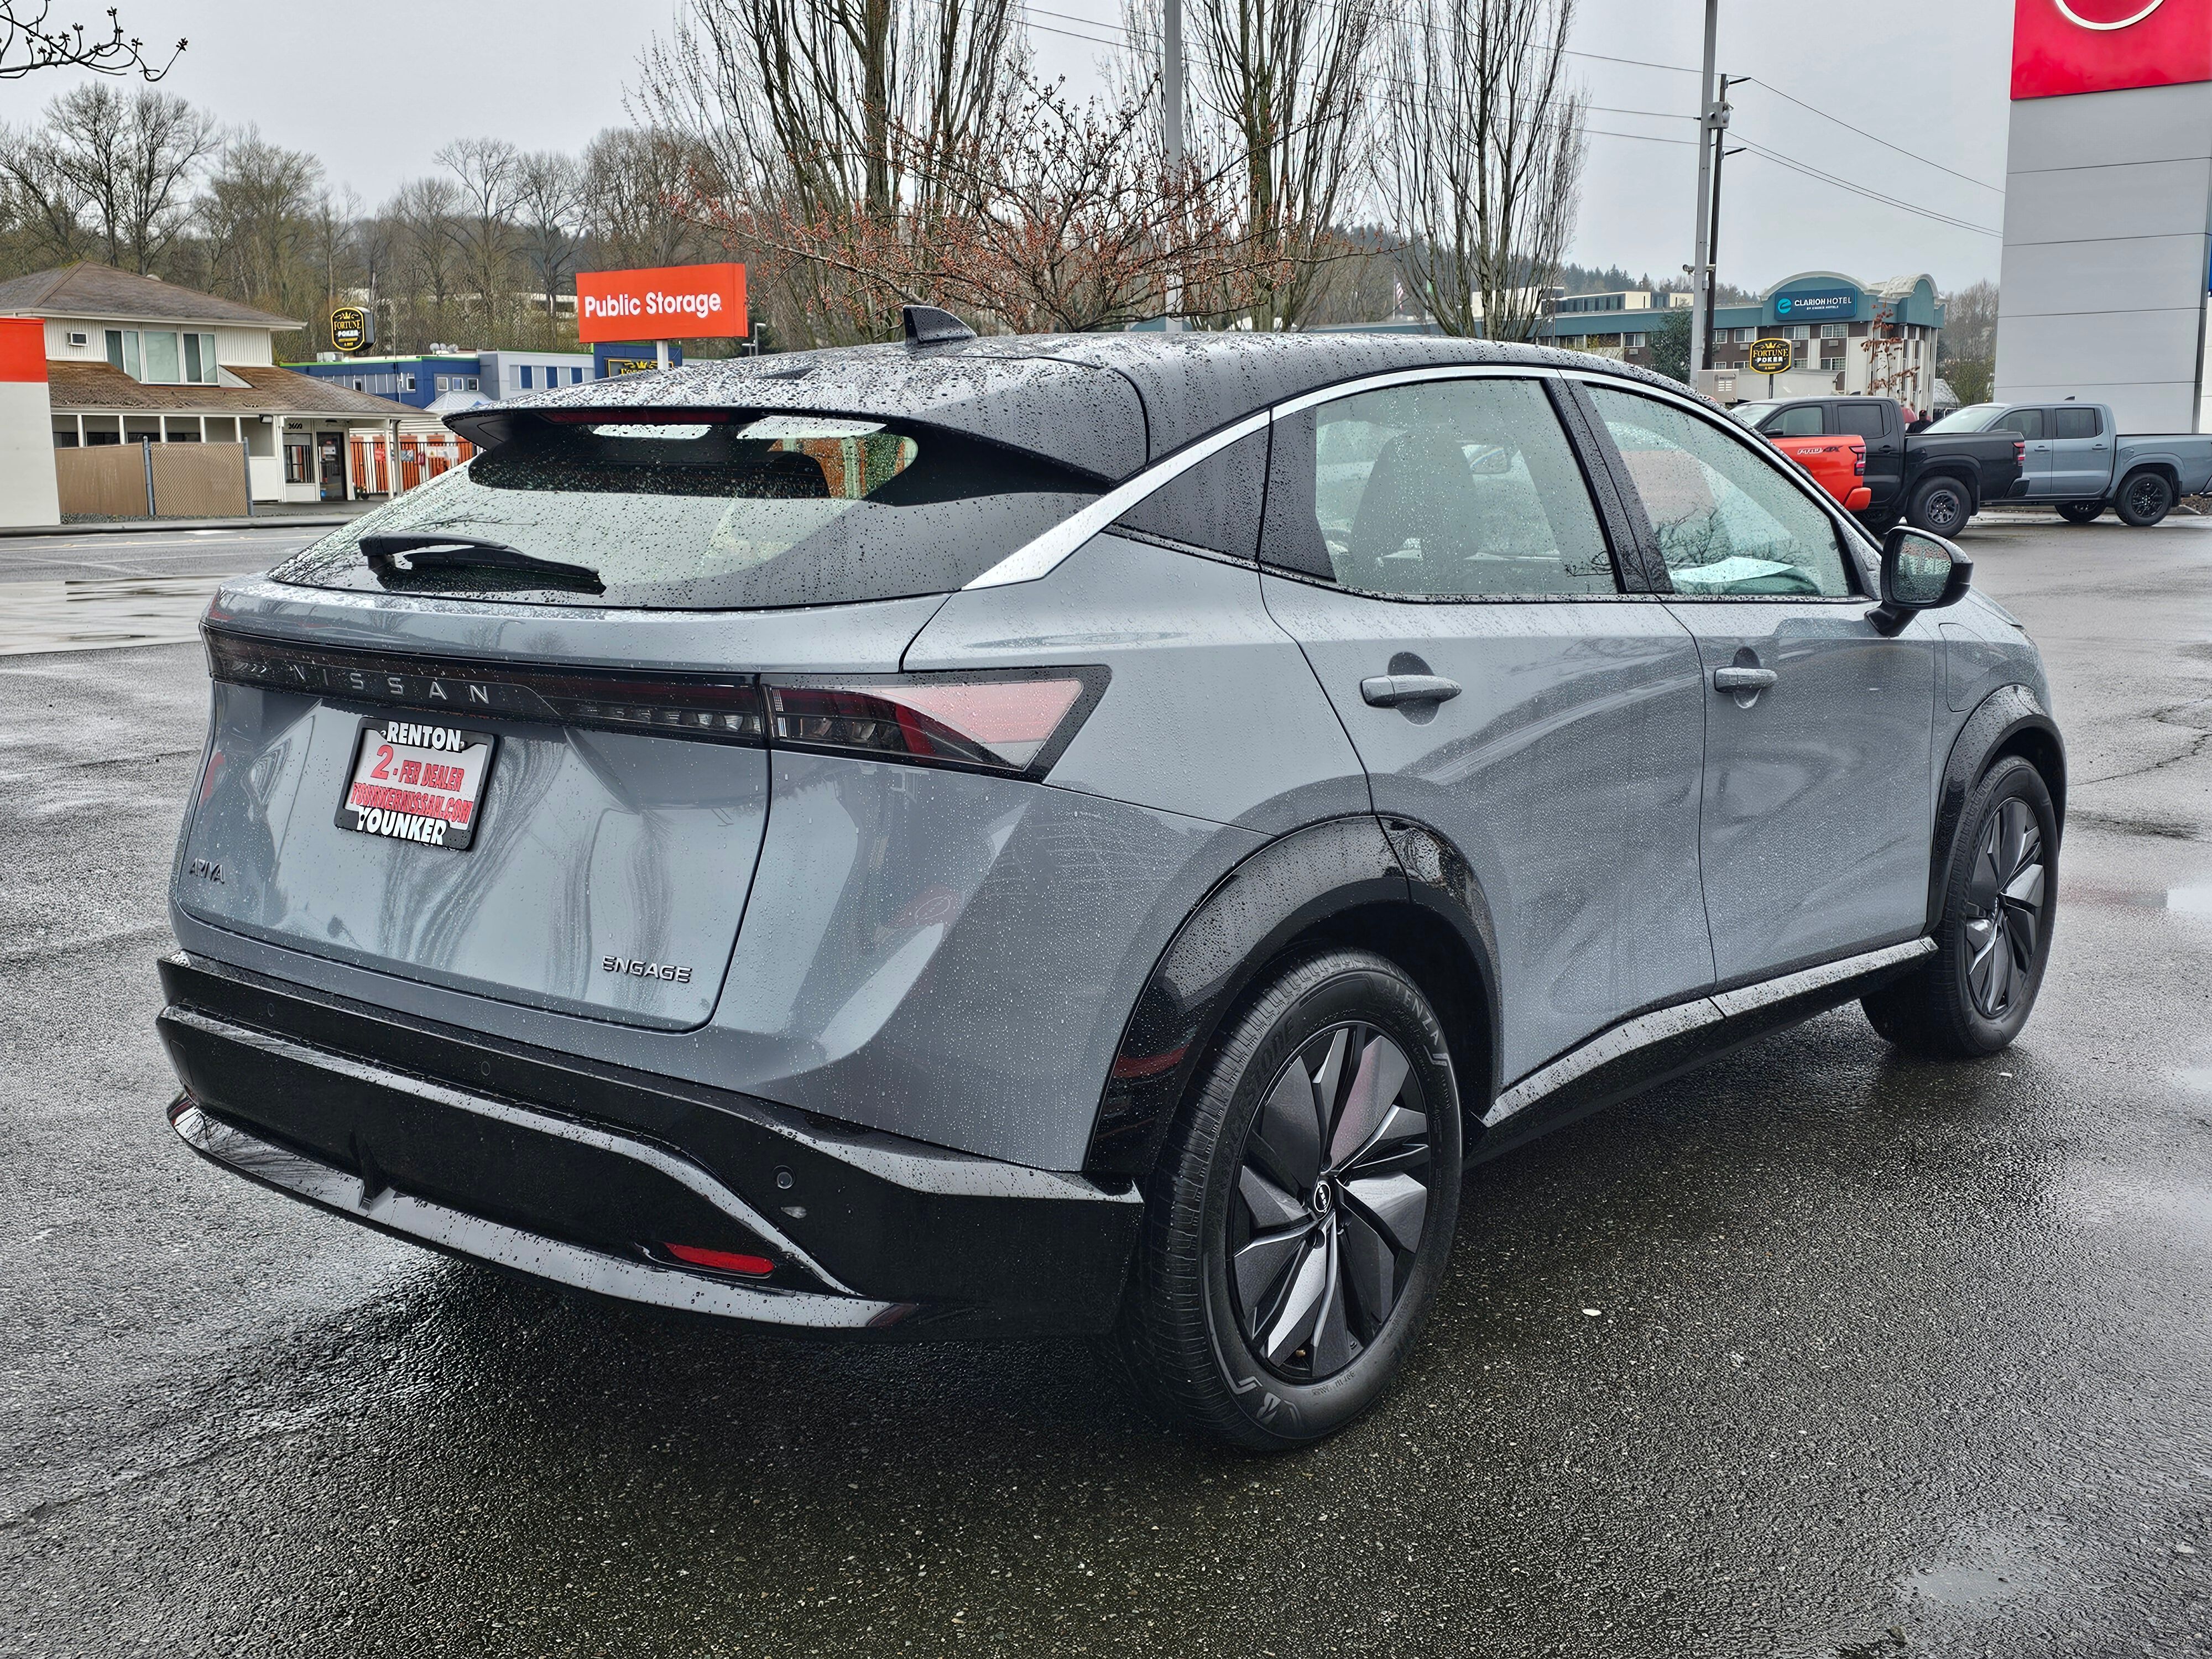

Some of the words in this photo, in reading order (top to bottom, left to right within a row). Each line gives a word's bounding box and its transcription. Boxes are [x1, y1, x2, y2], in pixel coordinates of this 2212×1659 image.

[585, 294, 641, 317] Public
[646, 291, 721, 318] Storage
[1794, 298, 1825, 306] CLARION
[333, 320, 362, 331] FORTUNE
[1752, 348, 1789, 358] FORTUNE
[293, 663, 489, 705] NISSAN
[387, 721, 462, 753] RENTON
[420, 763, 465, 792] DEALER
[356, 806, 447, 846] YOUNKER
[190, 858, 225, 884] ARIYA
[602, 955, 692, 983] ENGAGE
